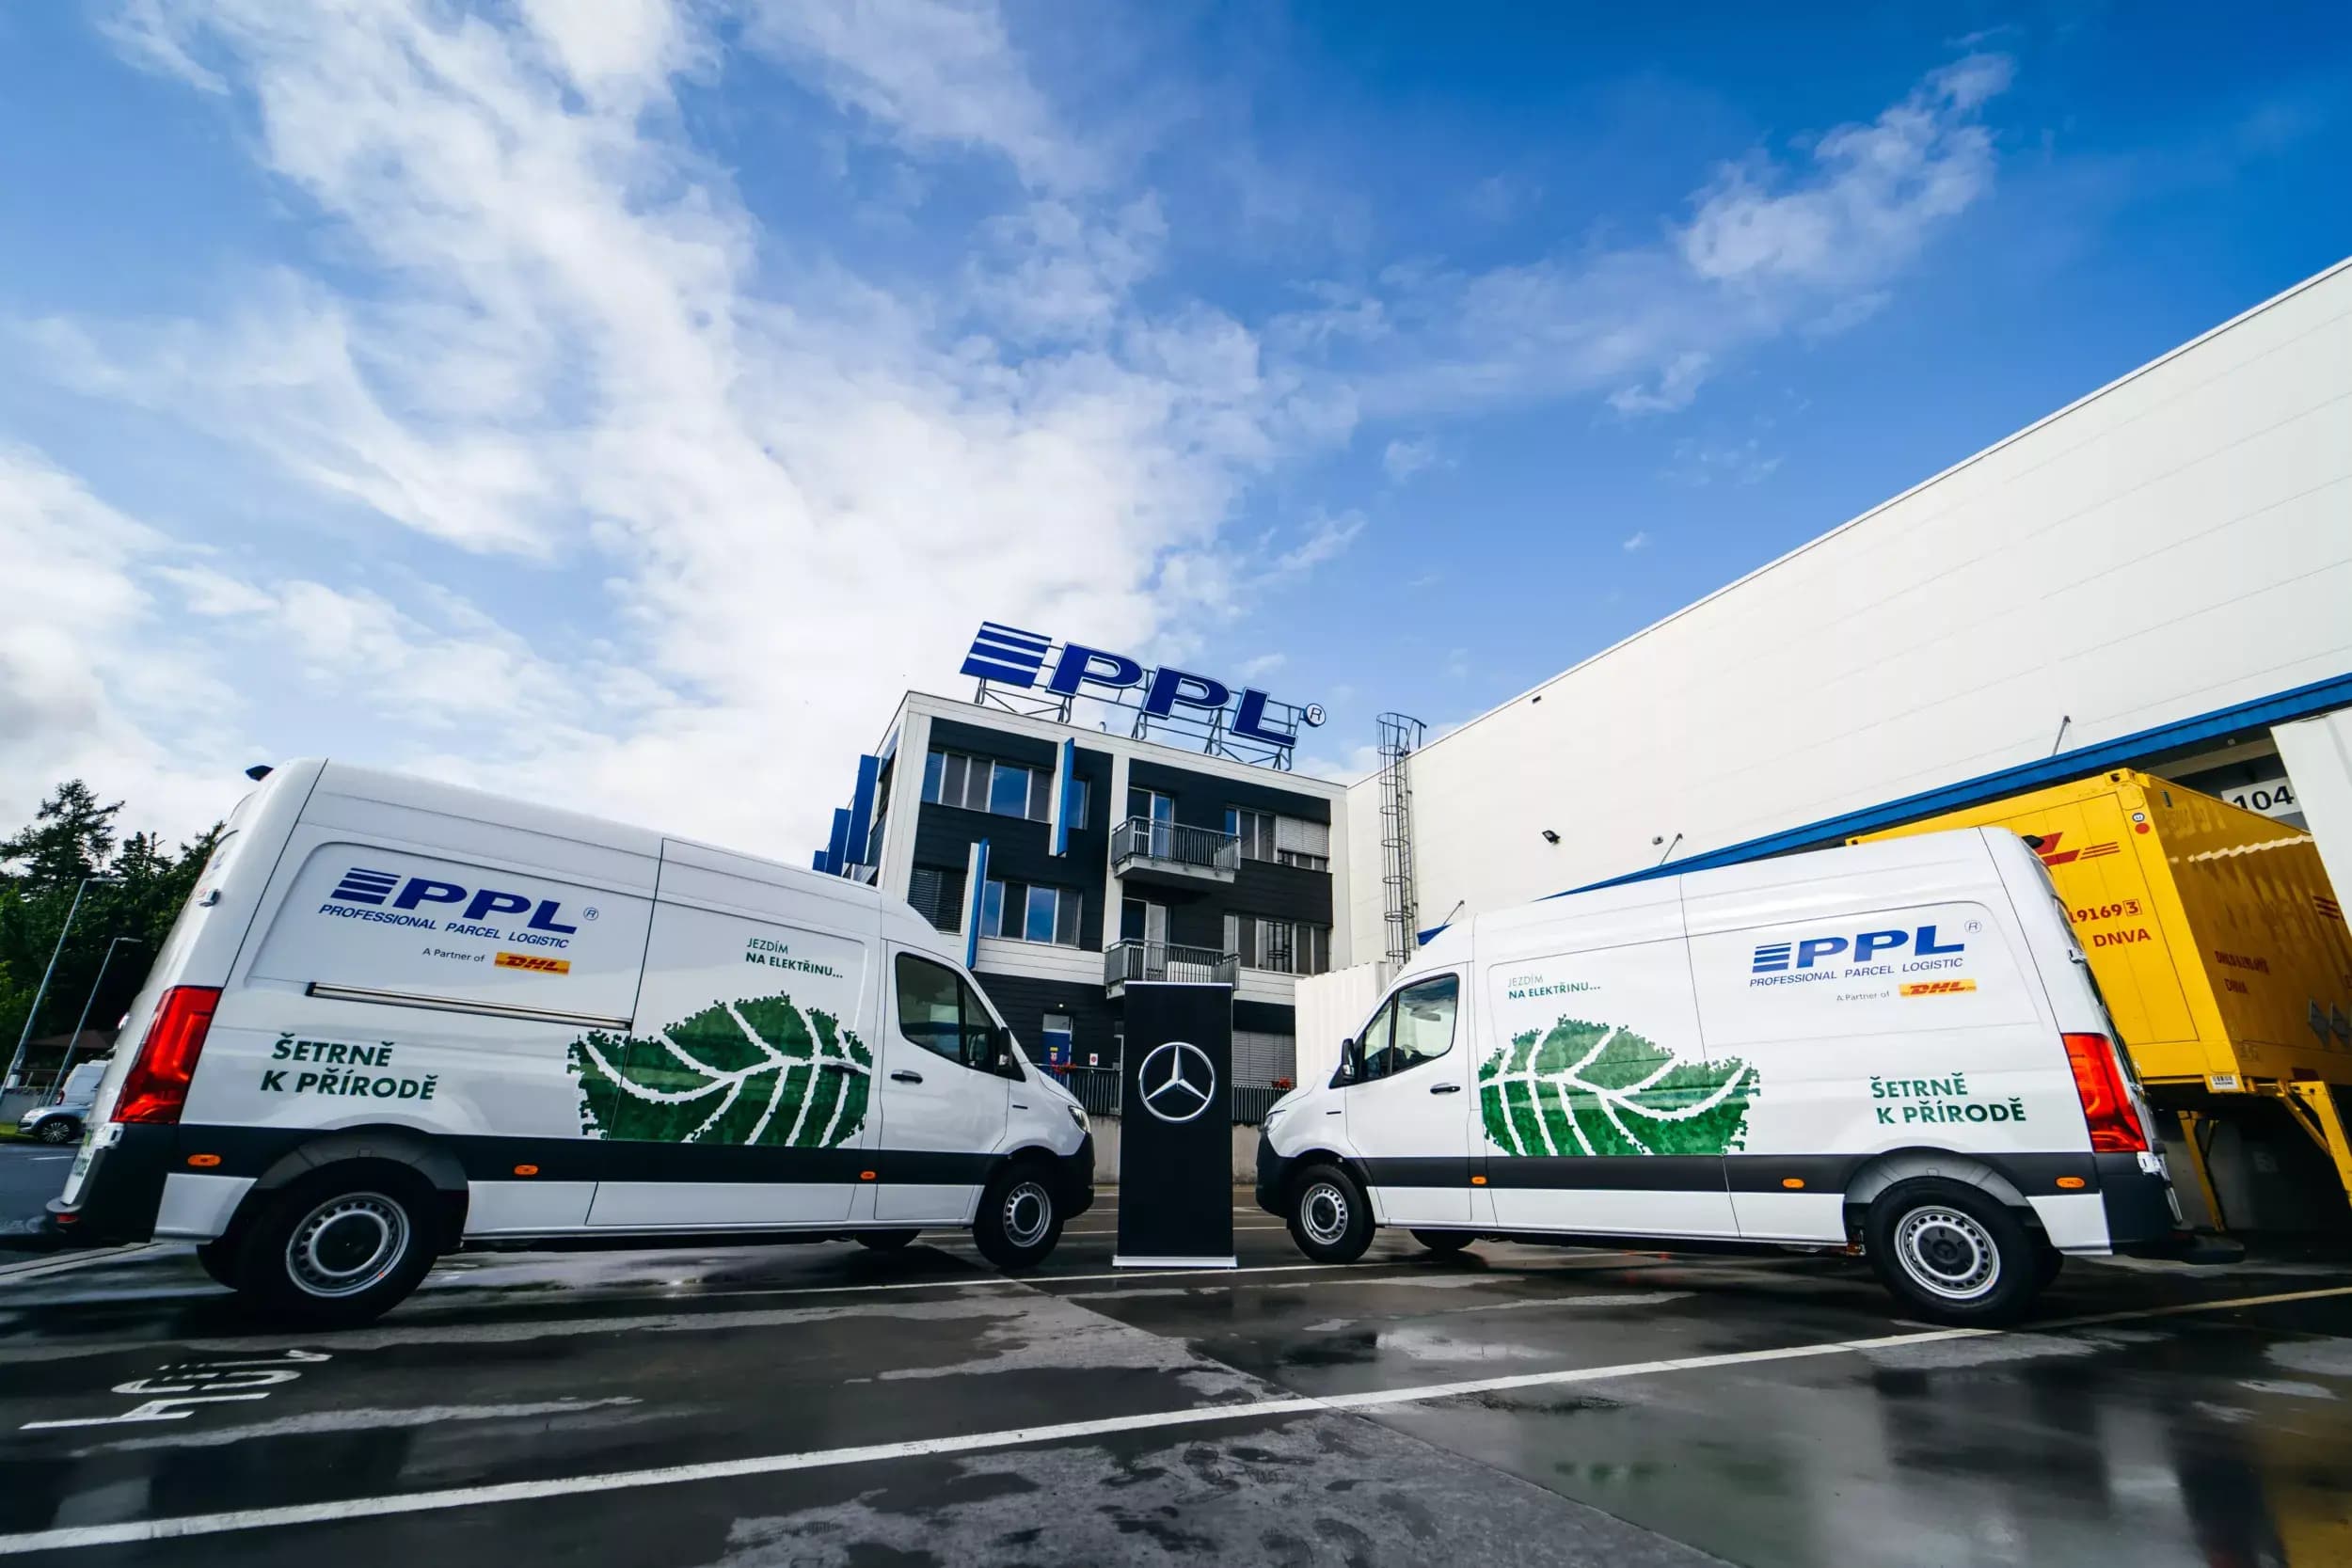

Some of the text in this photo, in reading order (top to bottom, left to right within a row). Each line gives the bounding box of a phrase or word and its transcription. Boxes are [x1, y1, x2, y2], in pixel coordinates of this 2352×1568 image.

[1046, 641, 1297, 749] PPL
[2233, 785, 2295, 811] 104
[392, 878, 578, 934] PPL
[318, 904, 569, 948] PROFESSIONAL PARCEL LOGISTIC
[2092, 928, 2152, 947] DNVA
[422, 947, 559, 972] A Partner of DHL
[745, 952, 765, 964] NA
[746, 938, 788, 955] JEZDÍM
[1796, 926, 1964, 969] PPL
[1508, 974, 1543, 988] JEZDÍM
[1750, 958, 1963, 988] PROFESSIONAL PARCEL LOGISTIC
[1508, 990, 1525, 999] NA
[1845, 992, 1877, 1002] Partner
[1910, 982, 1965, 995] DHL
[272, 1032, 395, 1067] ŠETRNĚ
[260, 1068, 438, 1100] K PŘÍRODĚ
[1869, 1072, 1968, 1099] ŠETRNĚ
[1877, 1097, 2026, 1125] K PŘÍRODĚ
